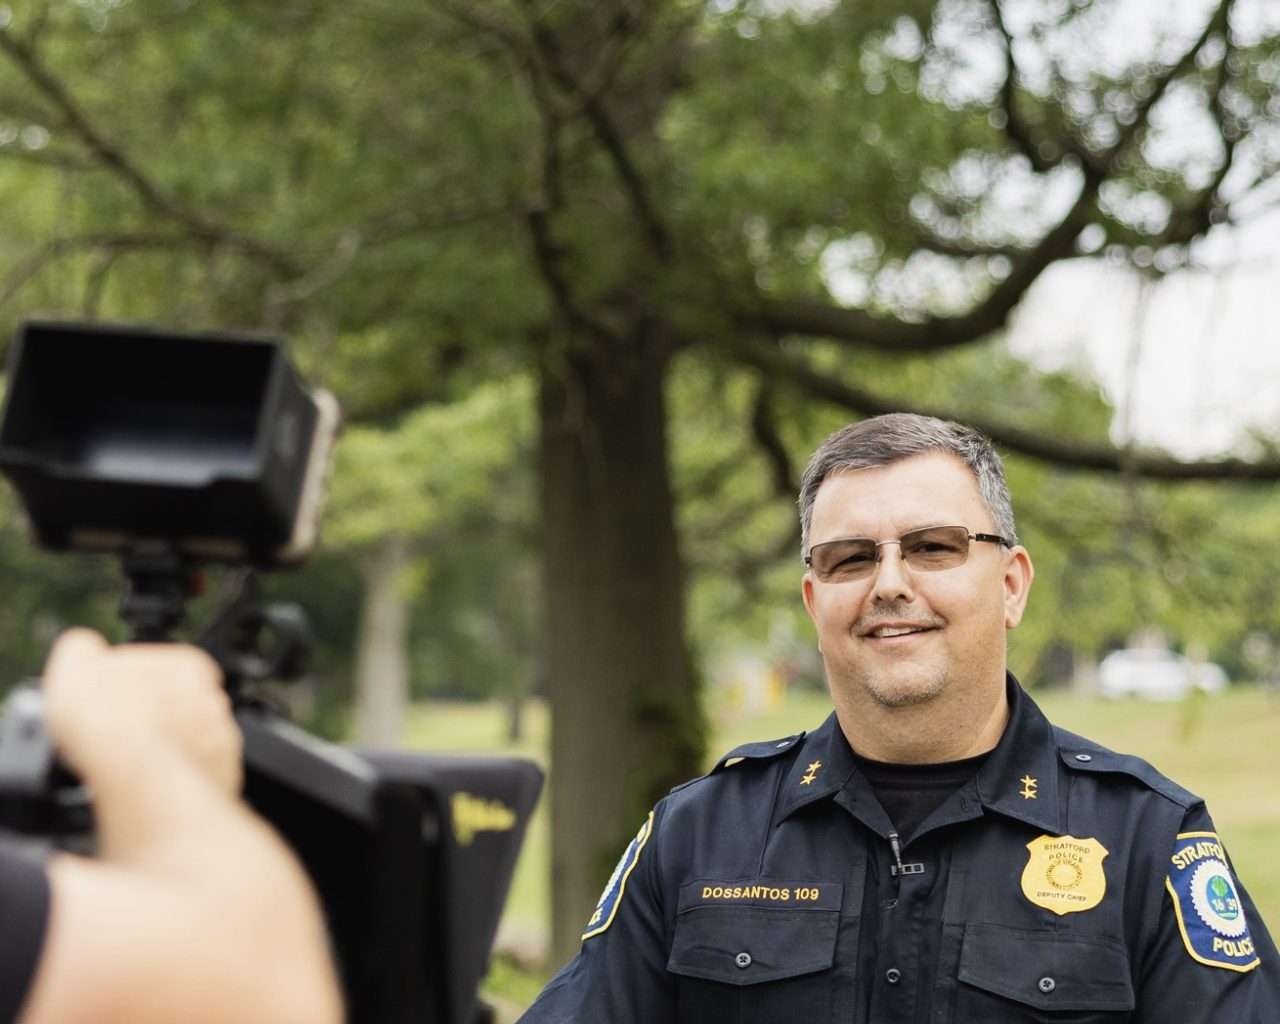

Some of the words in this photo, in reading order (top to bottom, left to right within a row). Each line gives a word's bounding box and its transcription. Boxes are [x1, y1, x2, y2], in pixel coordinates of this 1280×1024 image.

[1048, 851, 1083, 863] POLICE
[1171, 841, 1226, 870] STRATFO
[701, 886, 790, 900] DOSSANTOS
[793, 888, 820, 900] 109
[1213, 937, 1255, 957] POLIC
